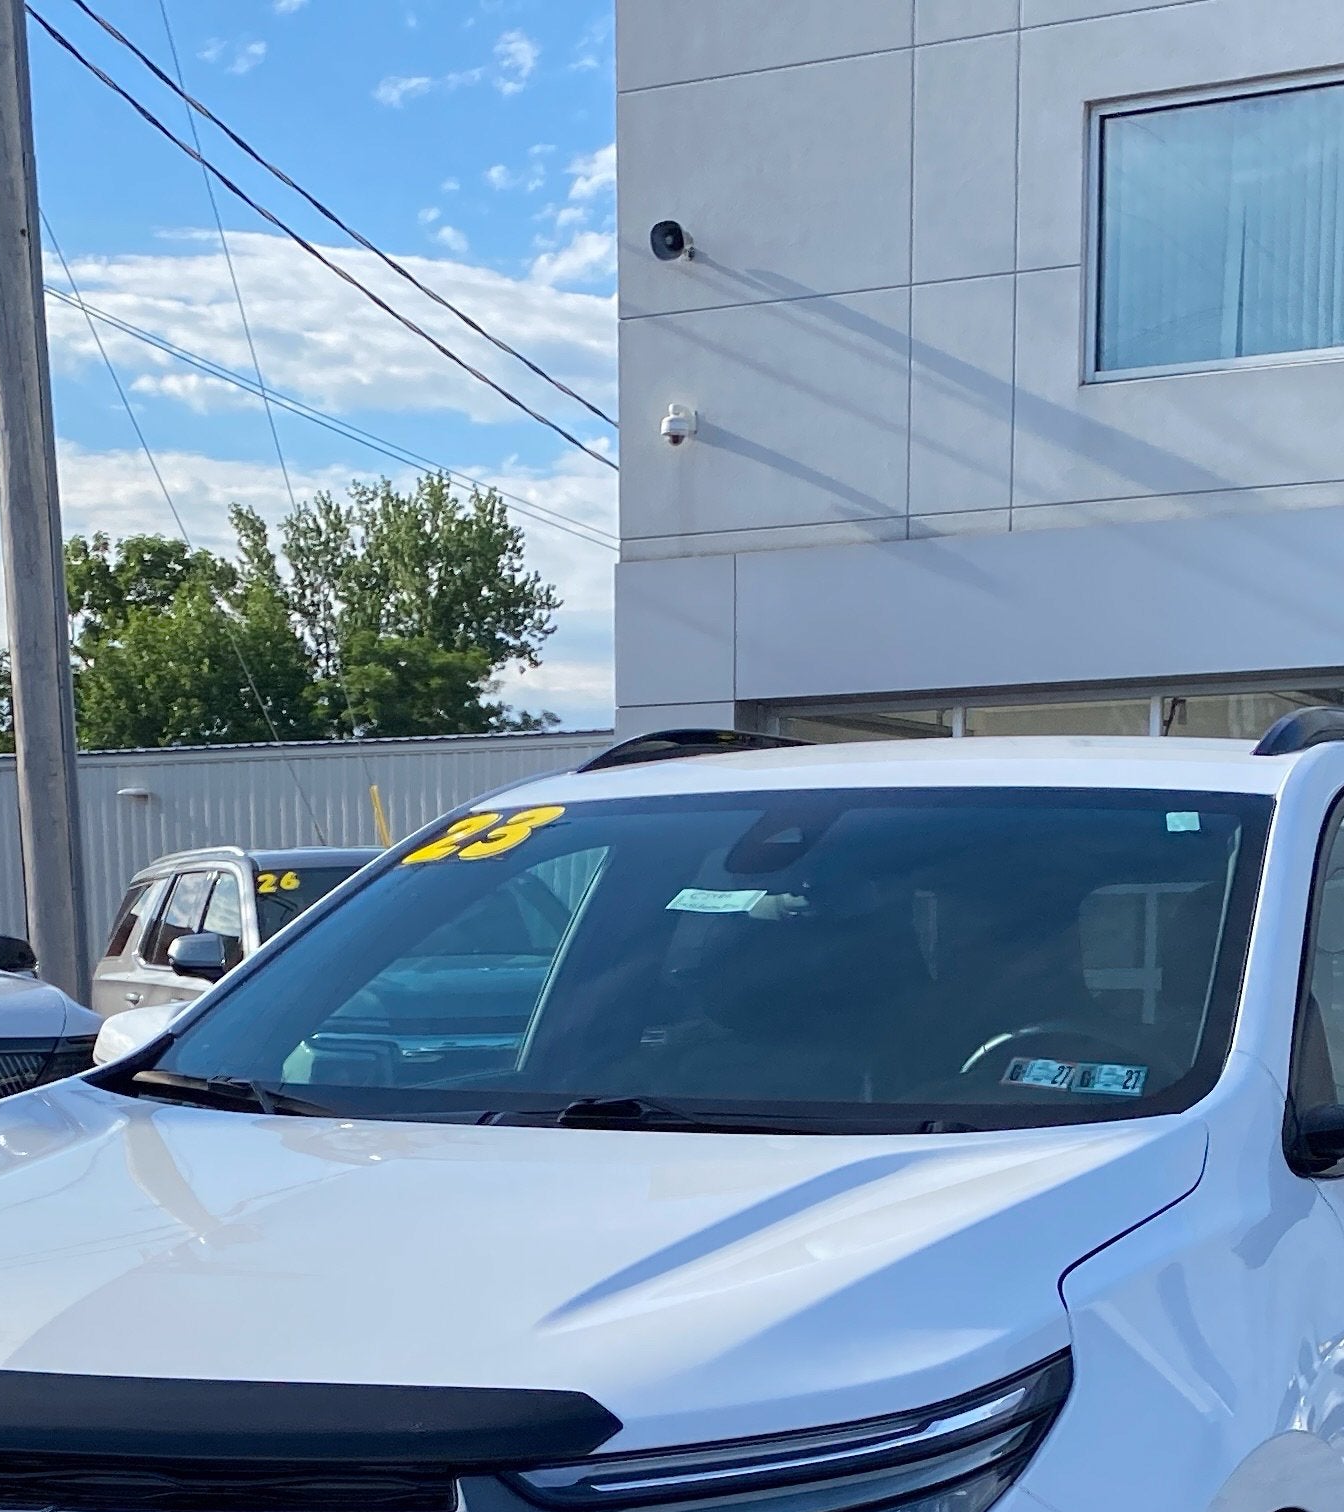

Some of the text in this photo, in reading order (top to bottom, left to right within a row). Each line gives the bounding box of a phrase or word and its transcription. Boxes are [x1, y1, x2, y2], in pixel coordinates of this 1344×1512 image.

[401, 805, 566, 861] 23
[256, 871, 301, 894] 26
[1051, 1065, 1073, 1085] 27
[1122, 1069, 1142, 1090] 27
